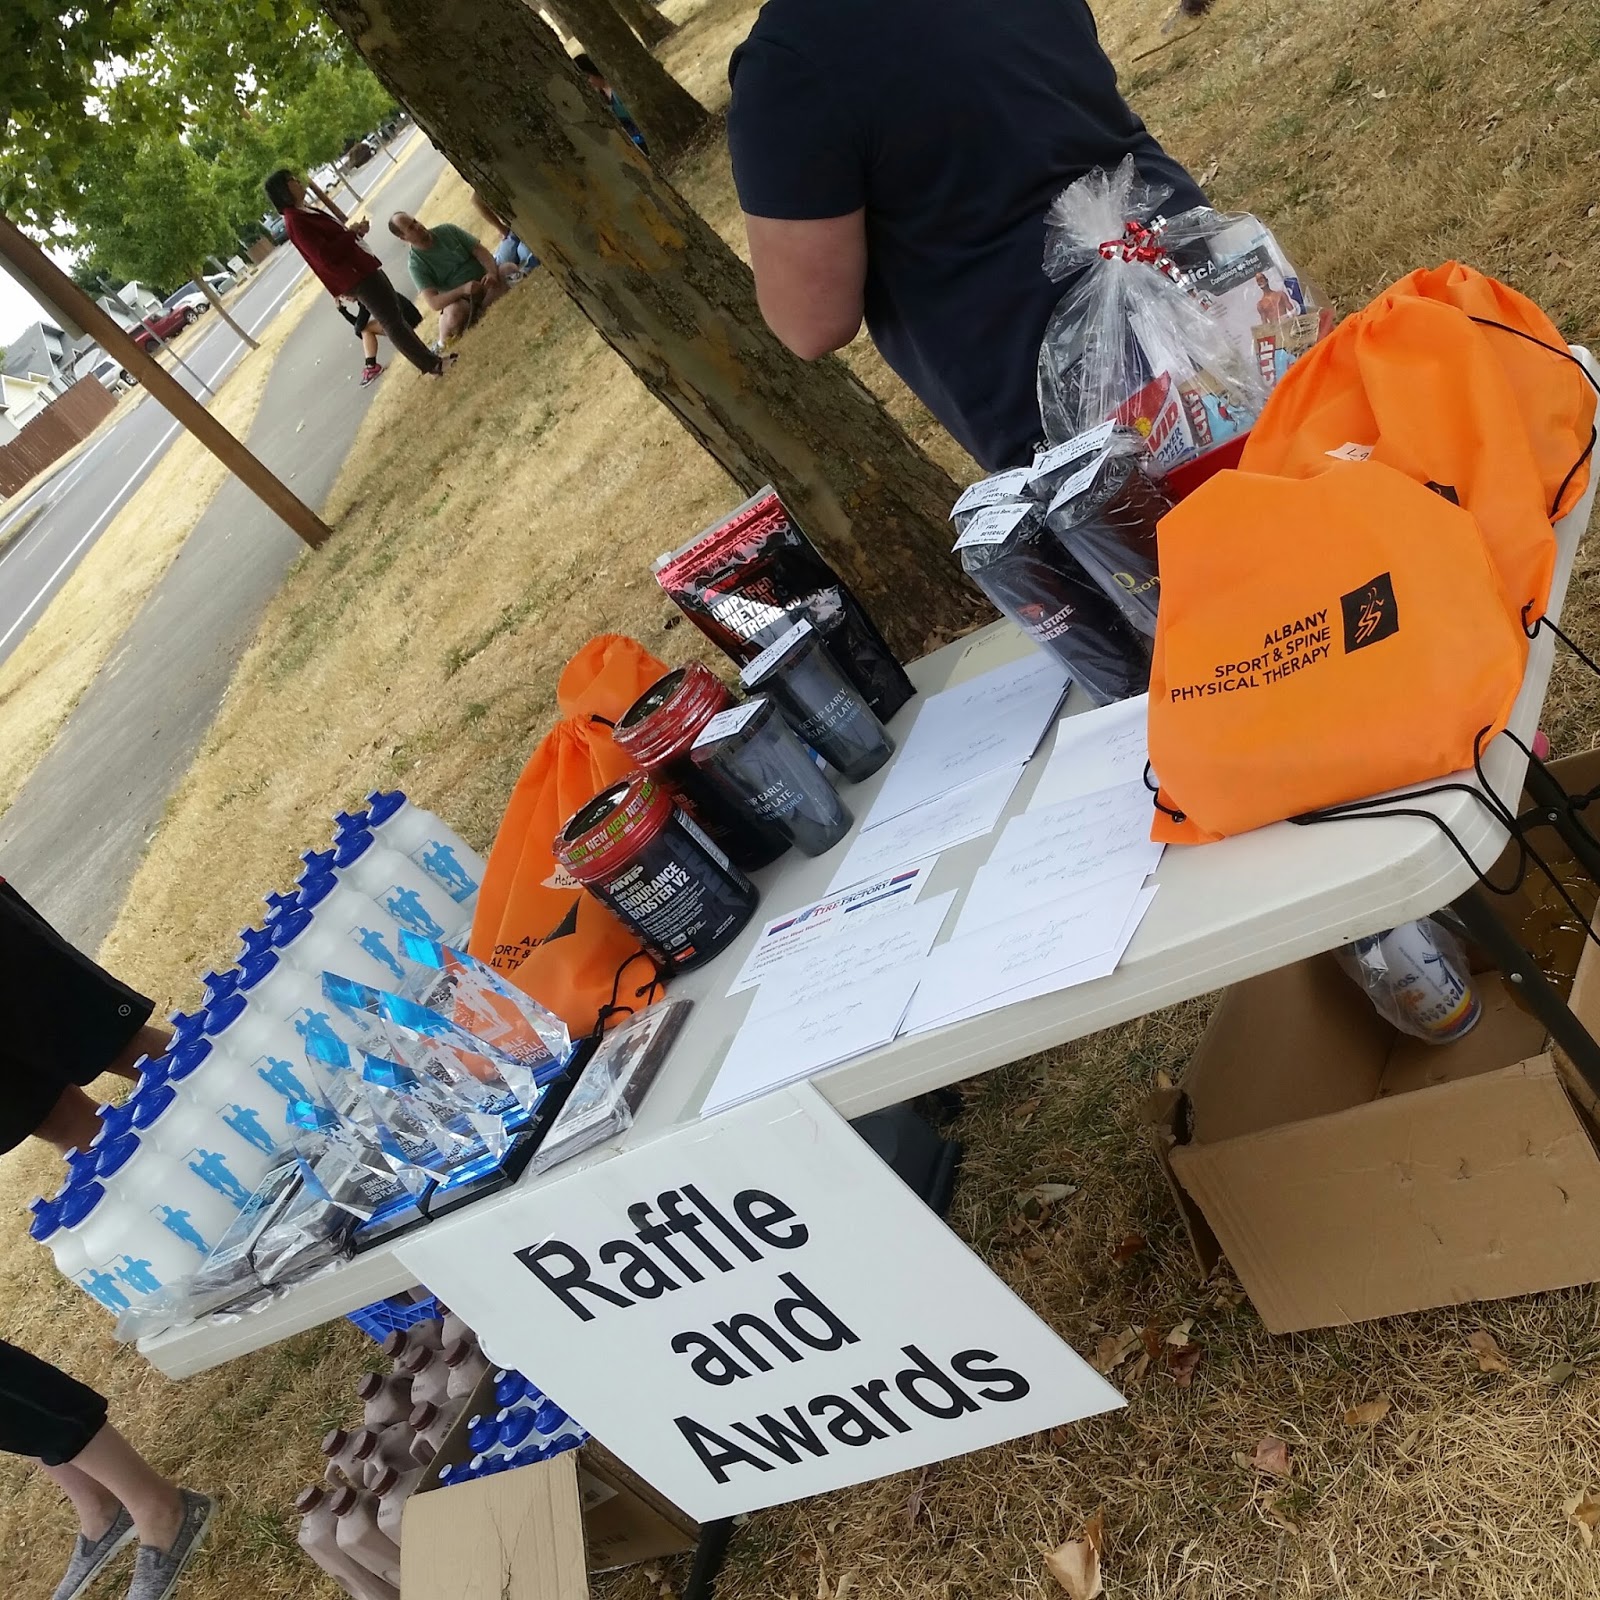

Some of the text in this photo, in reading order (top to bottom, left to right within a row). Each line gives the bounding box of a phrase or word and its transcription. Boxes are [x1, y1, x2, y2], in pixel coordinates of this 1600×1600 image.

[1259, 340, 1276, 387] CLIF
[1146, 400, 1179, 452] VID
[1185, 391, 1208, 436] CLIF
[712, 576, 774, 622] AMPLIFIED
[1264, 609, 1328, 649] ALBANY
[1171, 644, 1331, 703] PHYSICAL THERAPY
[1215, 627, 1331, 678] SPORT & SPINE
[798, 715, 813, 731] GET
[812, 710, 825, 723] UP
[824, 687, 848, 713] EARLY.
[807, 723, 826, 740] STAY
[825, 716, 838, 730] UP
[771, 789, 796, 809] LATE.
[782, 793, 804, 816] WORLD
[568, 845, 587, 861] NEW
[585, 831, 609, 853] NEW
[606, 814, 629, 835] NEW
[627, 793, 646, 817] NEW
[607, 865, 645, 895] AMP
[614, 880, 645, 902] AMPLIFIED
[619, 861, 681, 912] ENDURANCE
[627, 881, 675, 921] BOOSTER
[672, 869, 691, 893] V2
[509, 1041, 543, 1059] ERALL
[380, 1183, 401, 1197] PLACE
[513, 1184, 810, 1322] Raffle
[671, 1272, 861, 1386] and
[673, 1344, 1030, 1485] Awards
